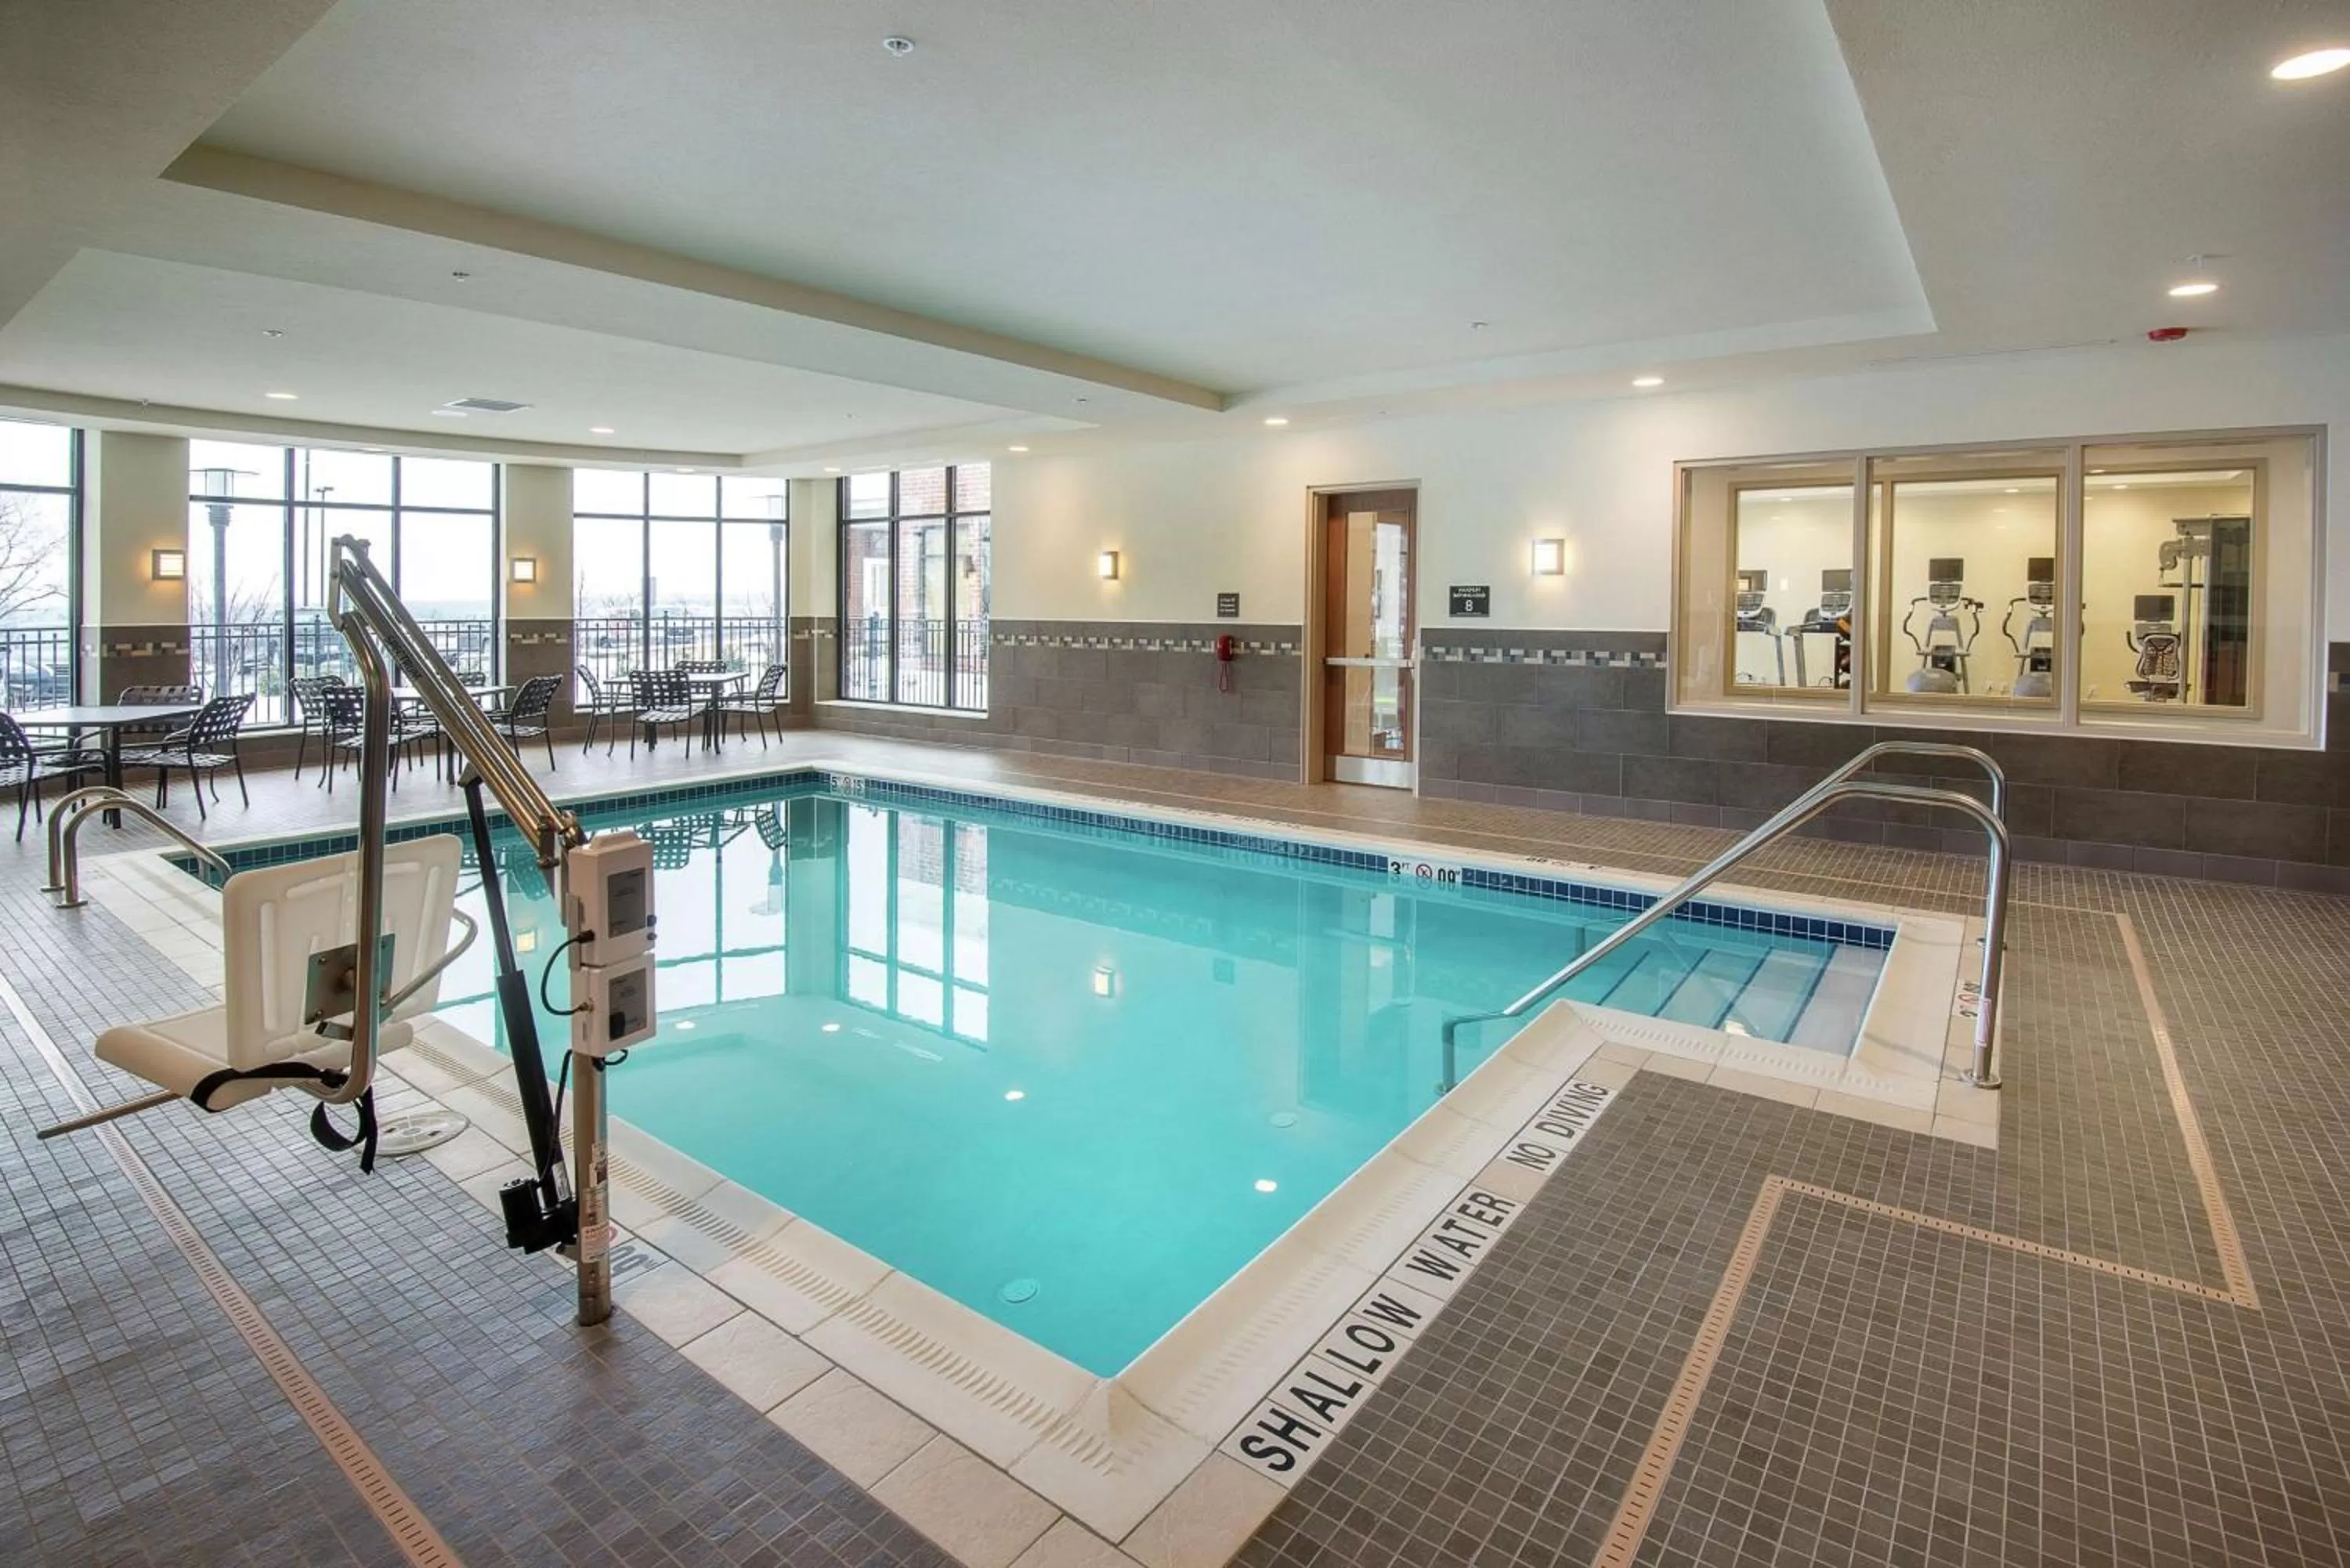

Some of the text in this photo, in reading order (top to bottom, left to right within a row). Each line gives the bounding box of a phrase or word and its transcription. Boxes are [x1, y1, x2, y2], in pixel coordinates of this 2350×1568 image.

[1239, 1081, 1610, 1472] SHALLOW WATER NO DIVING
